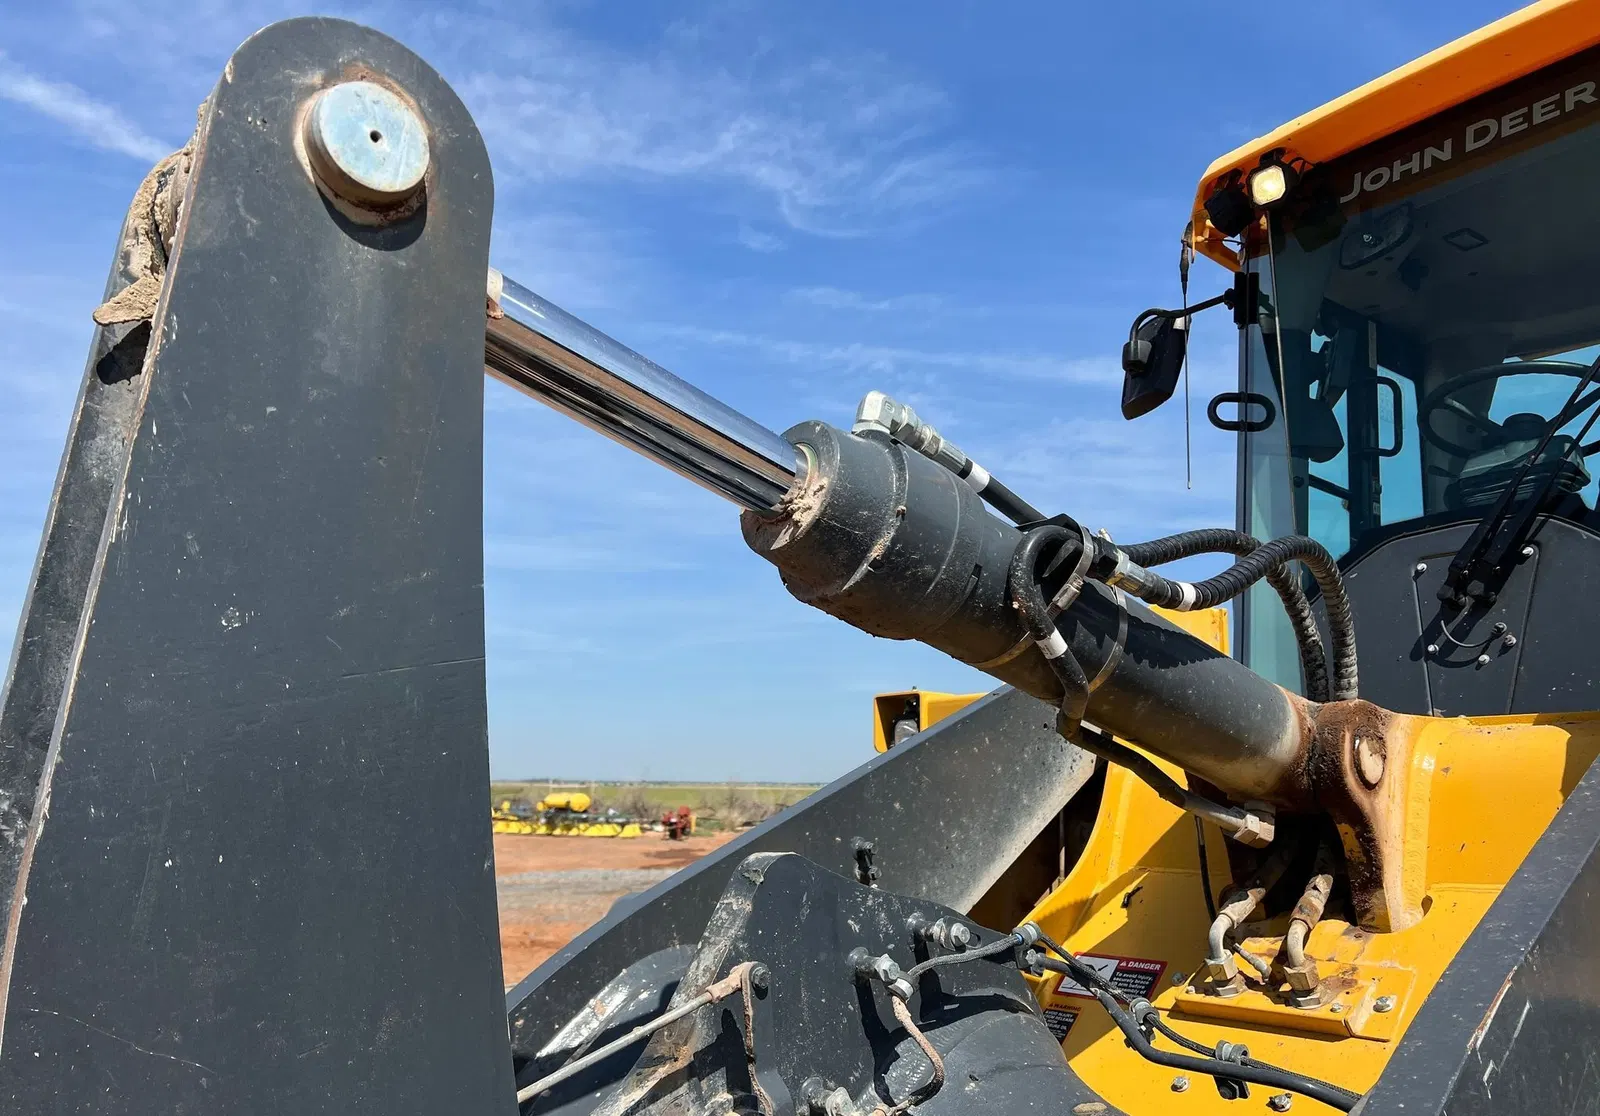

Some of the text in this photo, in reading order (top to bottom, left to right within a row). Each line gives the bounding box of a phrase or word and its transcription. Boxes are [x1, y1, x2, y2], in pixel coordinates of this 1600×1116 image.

[1340, 138, 1452, 204] JOHN
[1128, 961, 1161, 971] DANGER
[1054, 1003, 1082, 1012] WARNING
